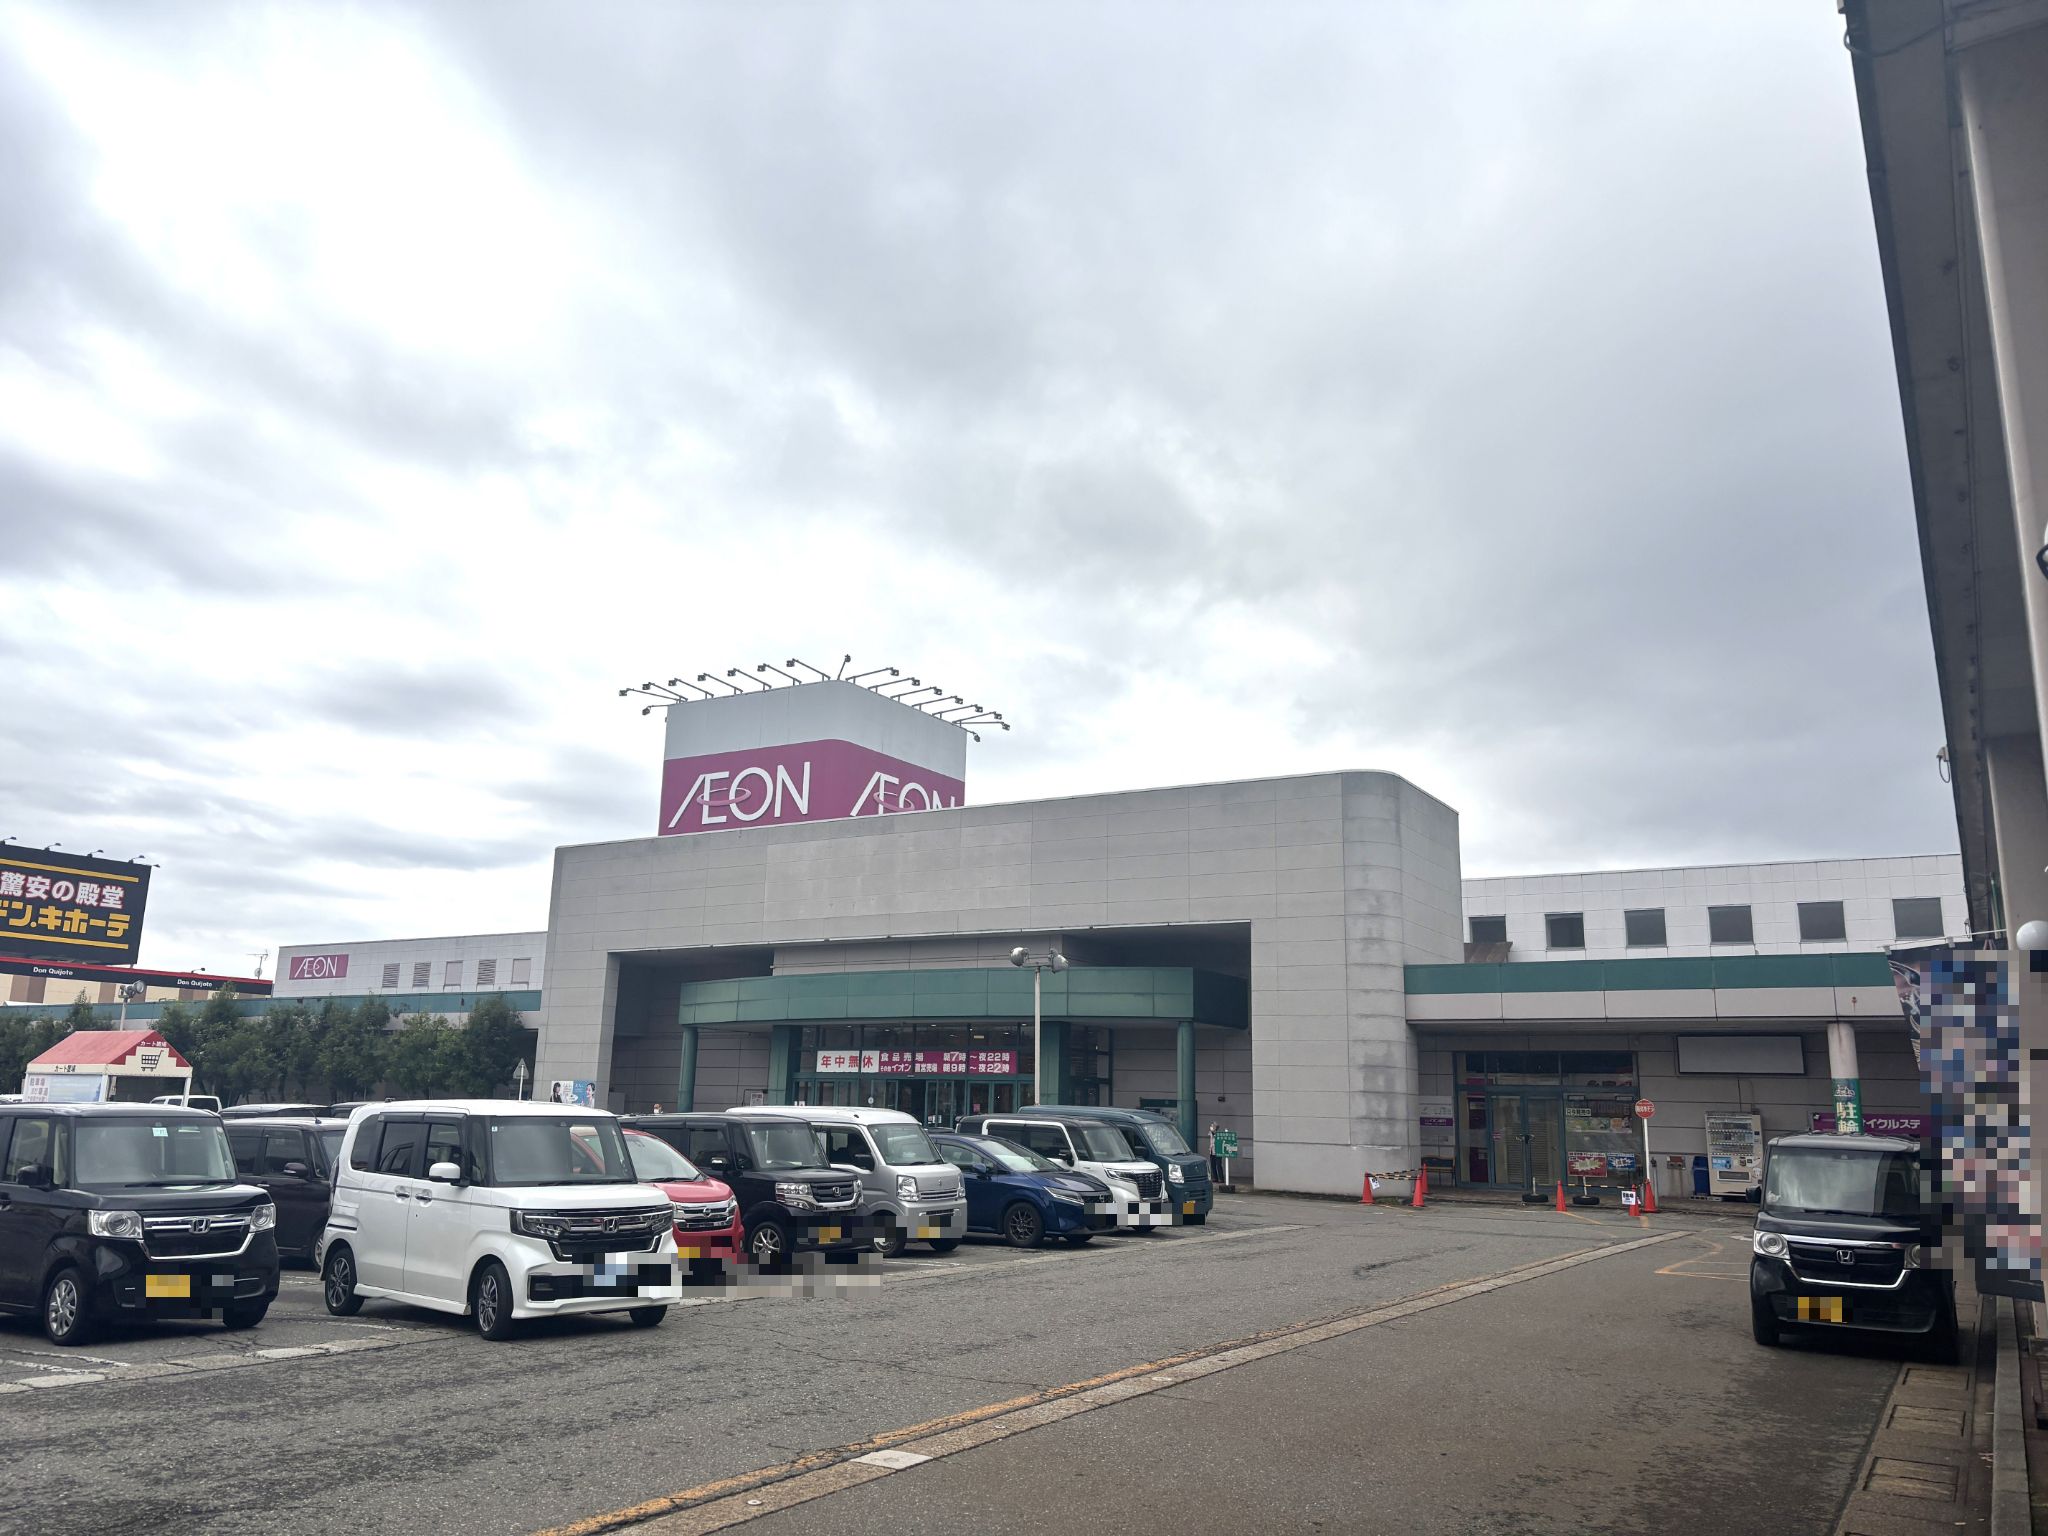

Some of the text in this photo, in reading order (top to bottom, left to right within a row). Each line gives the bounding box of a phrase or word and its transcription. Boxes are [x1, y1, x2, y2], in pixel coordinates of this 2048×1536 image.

[0, 871, 124, 909] 驚安の殿堂
[33, 966, 74, 976] Don Quijote
[191, 980, 213, 988] Quijote
[821, 1055, 874, 1069] 年中無休
